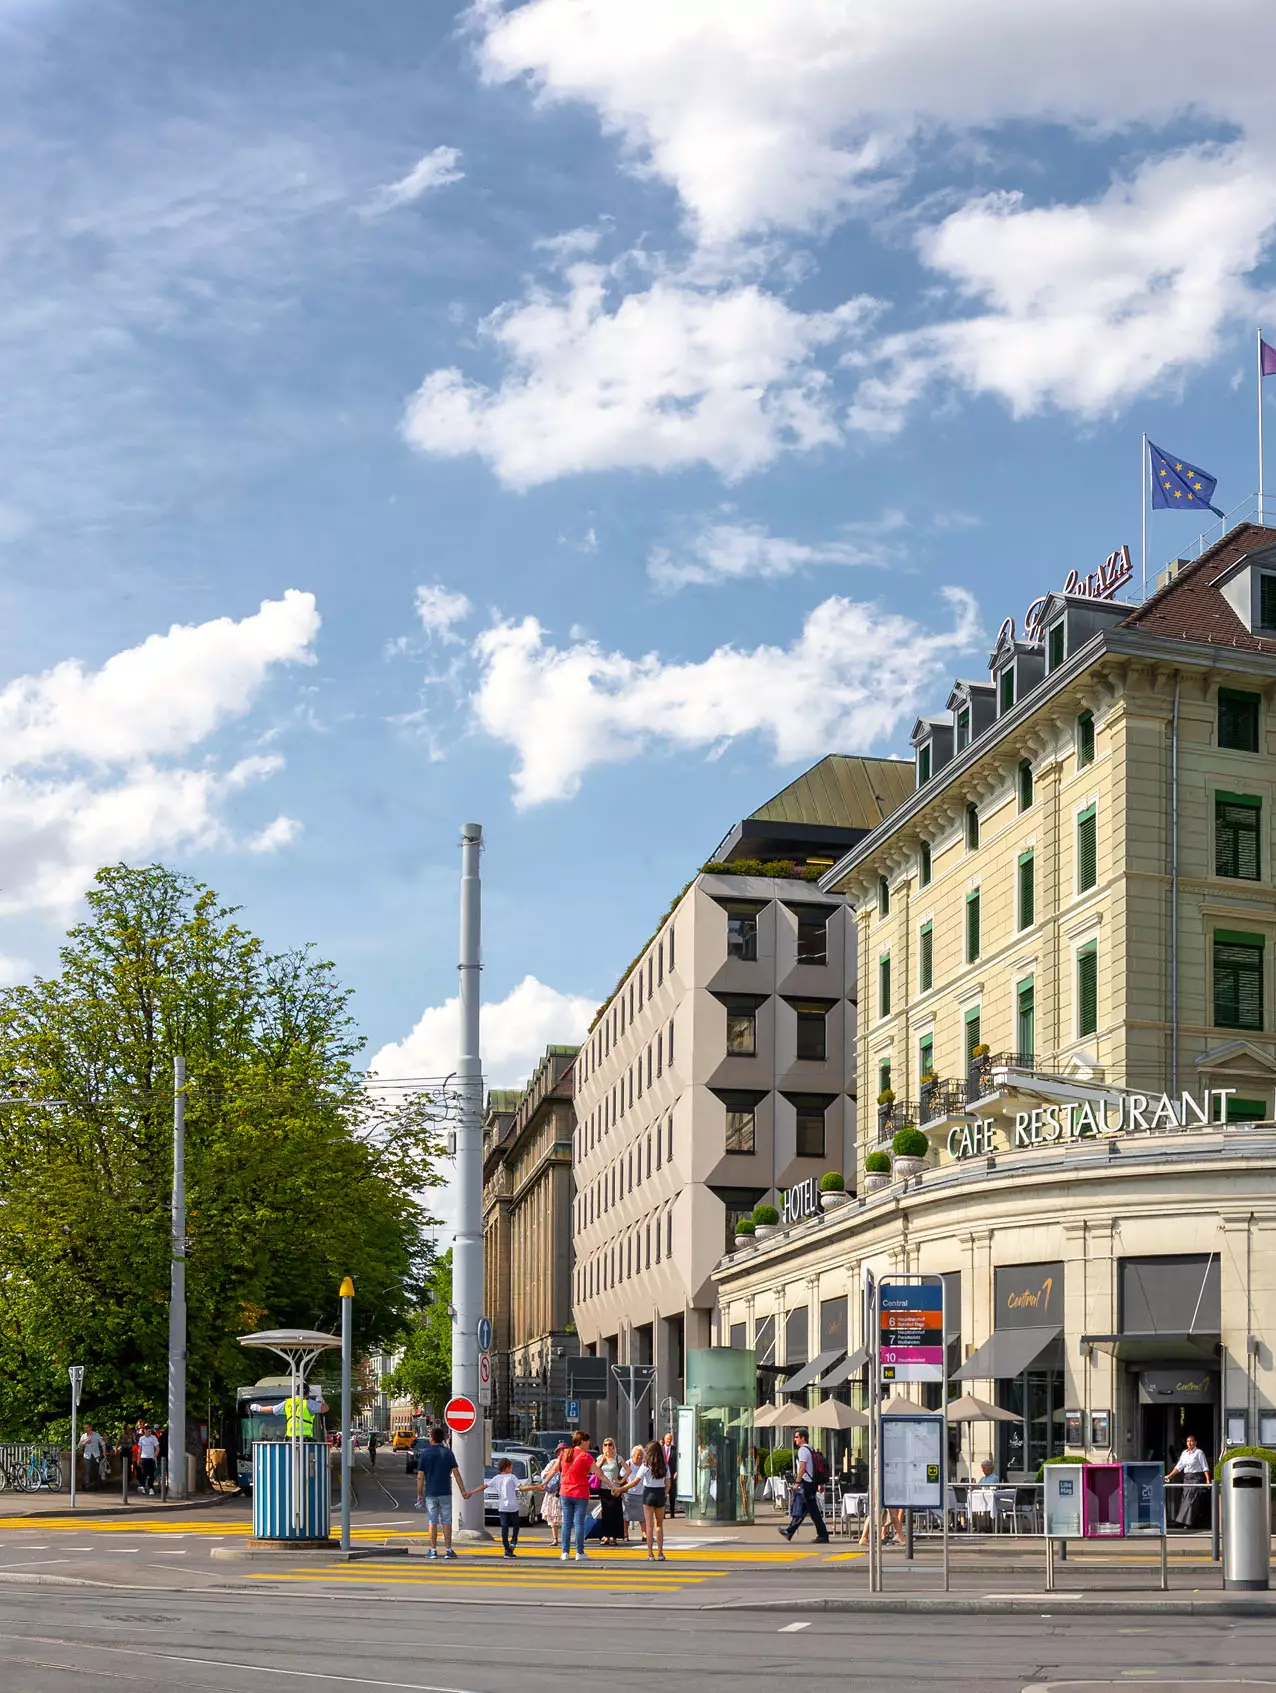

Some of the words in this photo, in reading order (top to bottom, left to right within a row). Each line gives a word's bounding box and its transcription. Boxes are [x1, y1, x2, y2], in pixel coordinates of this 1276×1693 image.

[1015, 1088, 1236, 1146] RESTAURANT
[783, 1177, 817, 1224] HOTEL
[882, 1299, 908, 1307] Central
[1007, 1289, 1042, 1309] Central
[889, 1317, 896, 1327] 6
[889, 1335, 896, 1345] 7
[885, 1353, 896, 1362] 10
[570, 1402, 577, 1411] P
